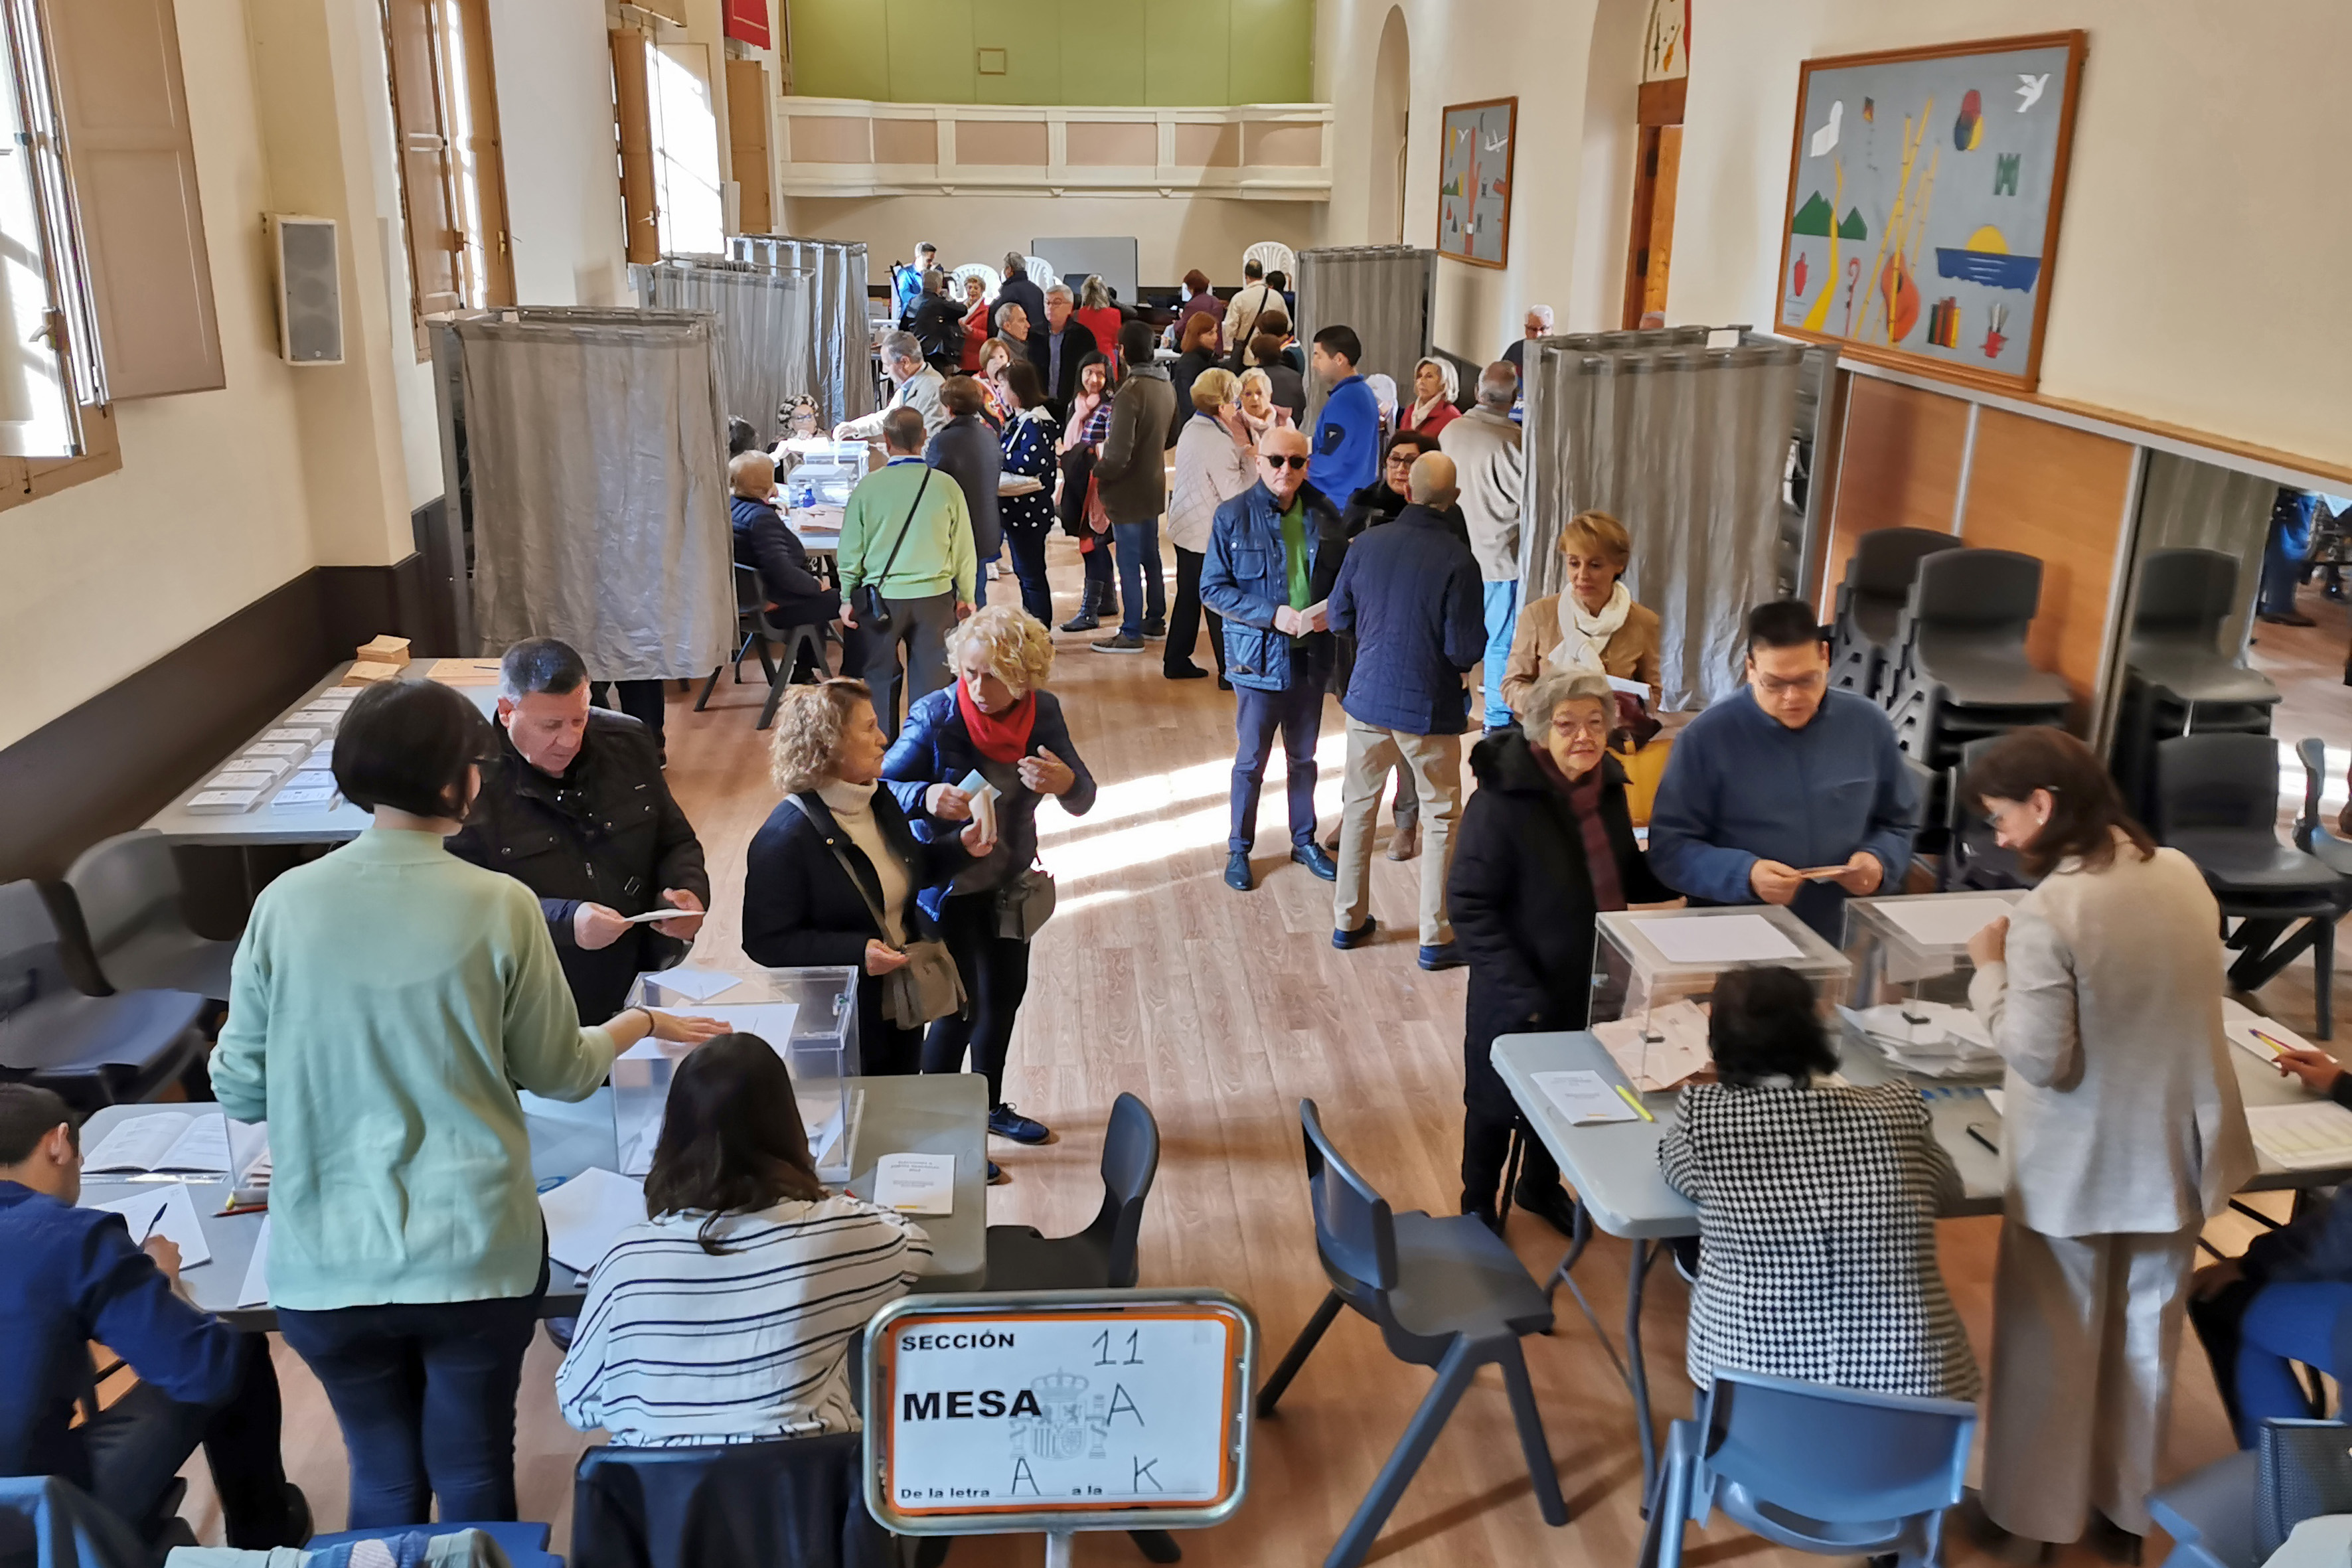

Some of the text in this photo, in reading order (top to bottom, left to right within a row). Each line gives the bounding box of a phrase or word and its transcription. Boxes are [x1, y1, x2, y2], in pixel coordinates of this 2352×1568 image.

[902, 1328, 1144, 1366] SECCIÓN 11
[903, 1383, 1145, 1427] MESA A
[901, 1454, 1163, 1498] De la letra A a la K
